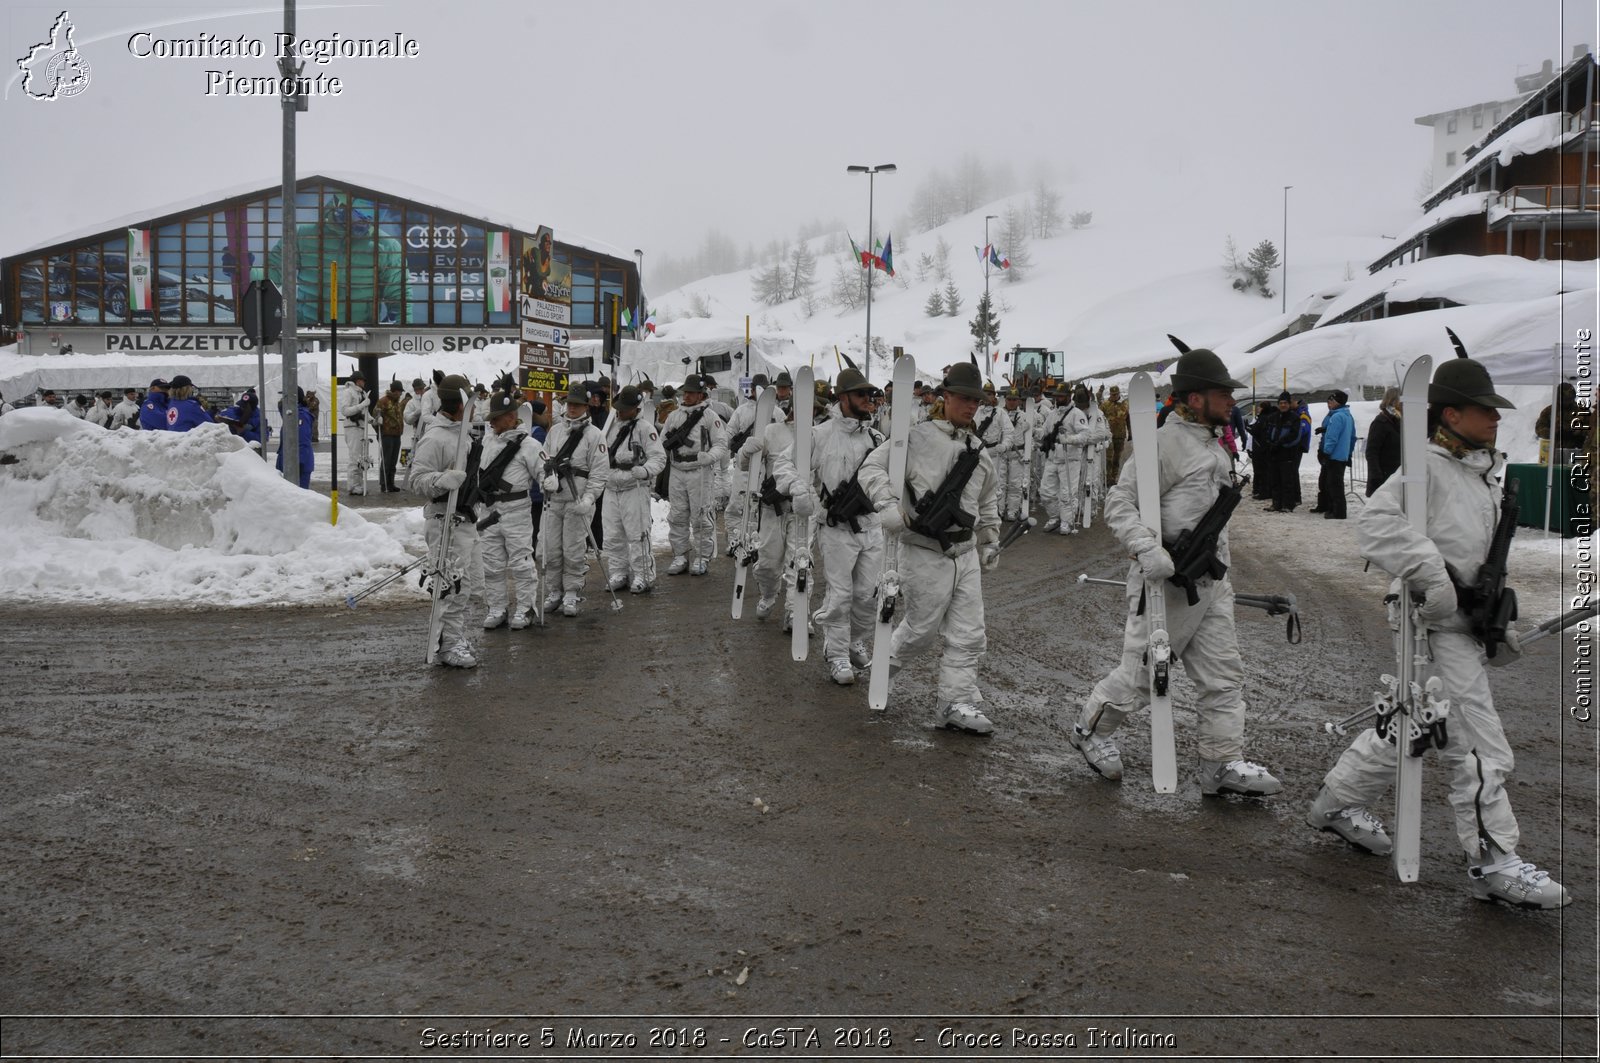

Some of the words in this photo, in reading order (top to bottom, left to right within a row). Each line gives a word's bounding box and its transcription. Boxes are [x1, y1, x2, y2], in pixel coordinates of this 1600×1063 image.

[409, 270, 480, 283] starts
[537, 301, 563, 313] PALAZZETTO
[535, 309, 550, 318] DELLO
[550, 312, 565, 320] SPORT
[526, 327, 550, 338] PARCHEGGI
[106, 335, 255, 351] PALAZZETTO
[391, 336, 434, 352] dello
[527, 347, 547, 356] CHIESETTA
[524, 354, 539, 363] REGINA
[528, 379, 555, 389] GAROFALO
